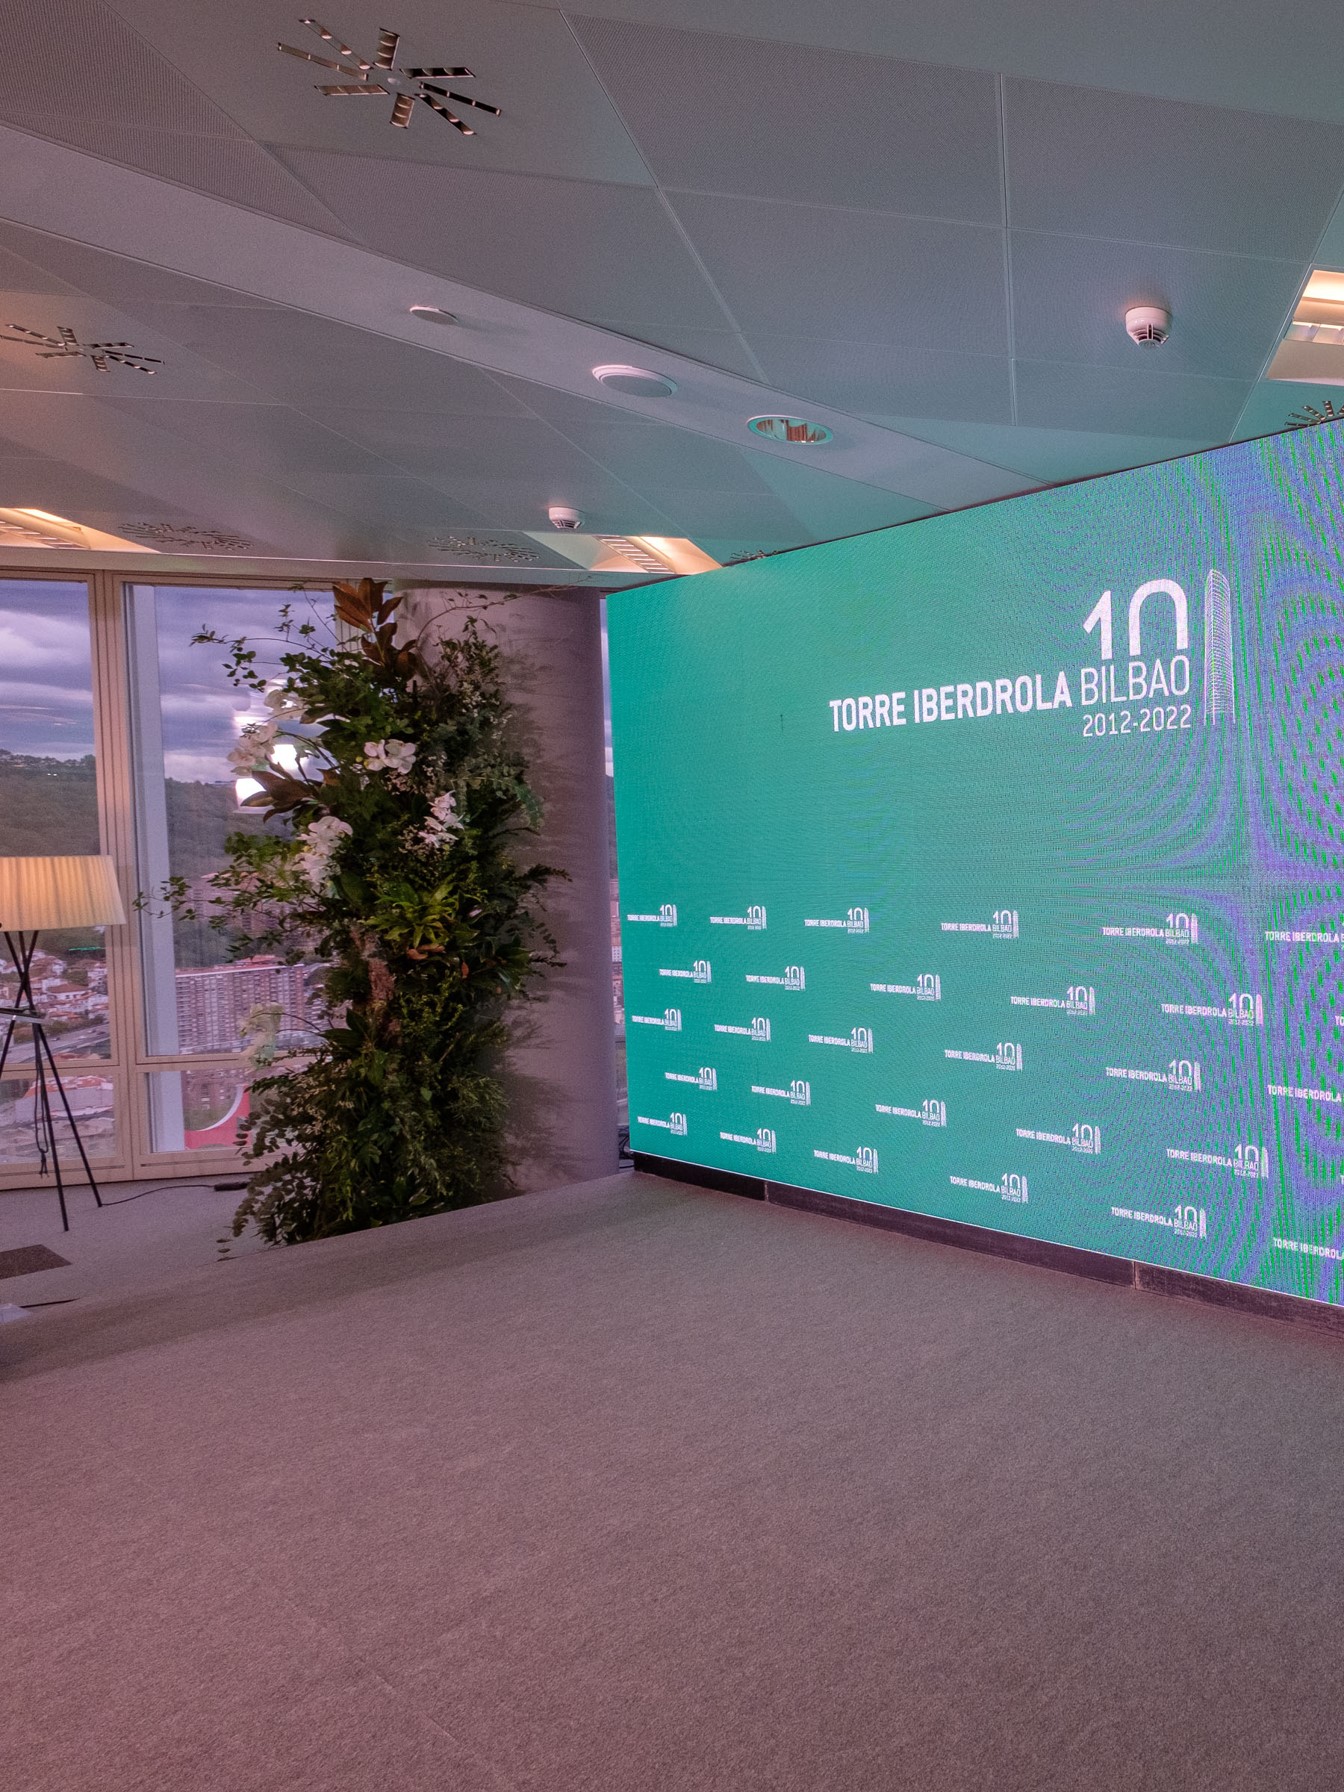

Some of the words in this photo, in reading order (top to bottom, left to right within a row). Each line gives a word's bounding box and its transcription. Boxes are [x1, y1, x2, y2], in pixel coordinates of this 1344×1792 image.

[1083, 578, 1189, 660] 10
[829, 691, 906, 732] TORRE
[914, 671, 1072, 723] IBERDROLA
[1081, 655, 1190, 706] BILBAO
[1083, 704, 1191, 737] 2012-2022
[660, 904, 672, 916] 10
[747, 906, 761, 918] 10
[847, 907, 863, 921] 10
[993, 910, 1012, 924] 10
[941, 923, 959, 931] TORRE
[1166, 913, 1189, 929] 10
[1102, 927, 1124, 936] TORRE
[1125, 928, 1164, 937] IBERDROLA
[1265, 932, 1291, 941] TORRE
[1293, 932, 1340, 943] IBERDROLA
[693, 960, 706, 972] 10
[785, 966, 799, 978] 10
[917, 974, 934, 988] 10
[1067, 986, 1087, 1001] 10
[1010, 997, 1030, 1006] TORRE
[1229, 993, 1253, 1010] 10
[664, 1009, 677, 1020] 10
[1161, 1004, 1184, 1014] TORRE
[1185, 1006, 1227, 1017] IBERDROLA
[752, 1017, 765, 1030] 10
[851, 1027, 867, 1041] 10
[945, 1050, 963, 1059] TORRE
[996, 1042, 1015, 1057] 10
[699, 1067, 712, 1079] 10
[1169, 1060, 1192, 1076] 10
[1106, 1068, 1127, 1078] TORRE
[1128, 1070, 1167, 1083] IBERDROLA
[790, 1080, 805, 1093] 10
[1267, 1086, 1293, 1097] TORRE
[1295, 1088, 1342, 1102] IBERDROLA
[922, 1099, 939, 1114] 10
[670, 1112, 682, 1124] 10
[757, 1128, 771, 1141] 10
[1016, 1129, 1035, 1139] TORRE
[1072, 1124, 1093, 1140] 10
[856, 1146, 872, 1161] 10
[1166, 1149, 1189, 1160] TORRE
[1191, 1153, 1233, 1167] IBERDROLA
[1234, 1144, 1259, 1162] 10
[950, 1176, 968, 1187] TORRE
[1002, 1173, 1021, 1189] 10
[1111, 1207, 1133, 1219] TORRE
[1134, 1211, 1173, 1227] IBERDROLA
[1174, 1205, 1197, 1222] 10
[1273, 1238, 1299, 1251] TORRE
